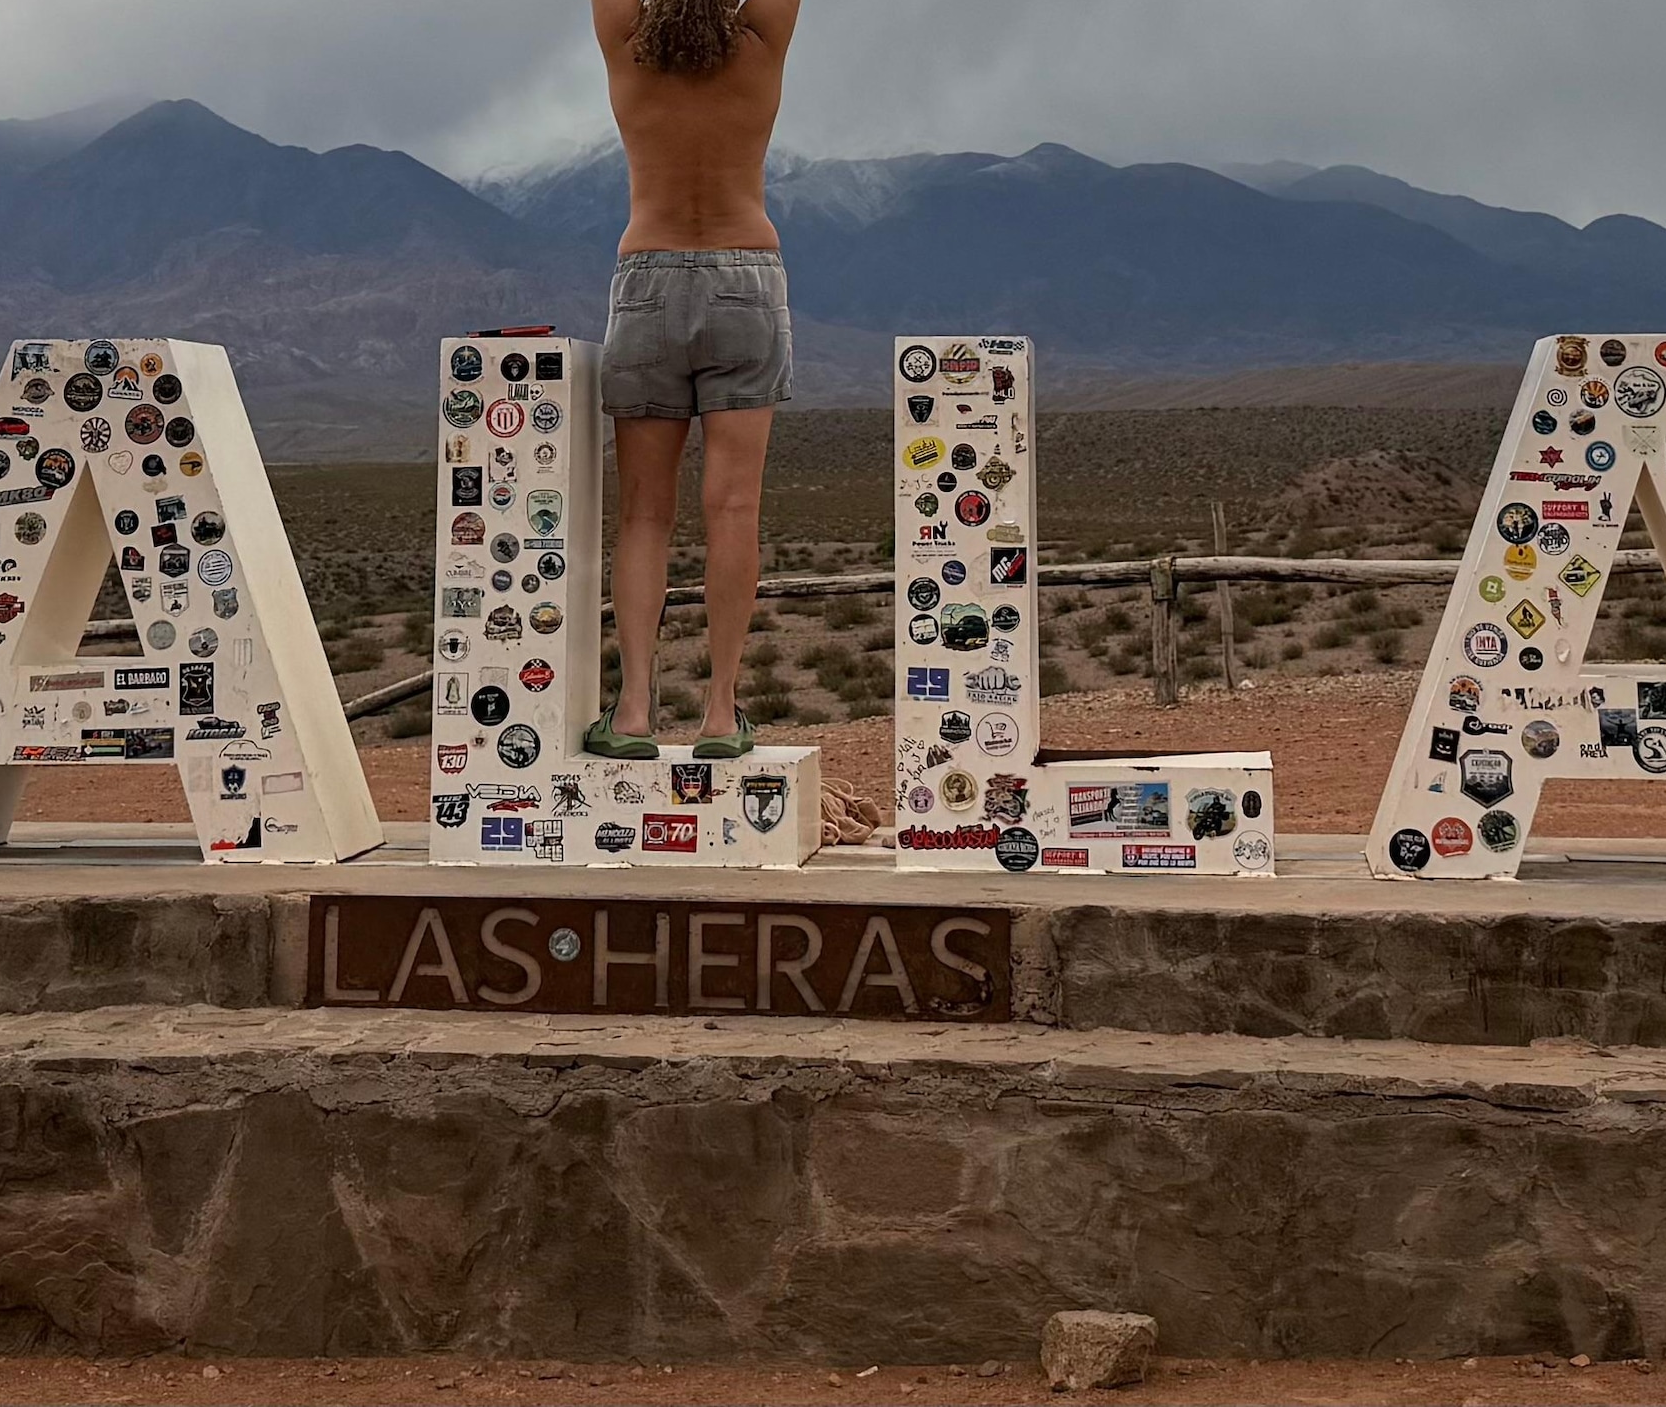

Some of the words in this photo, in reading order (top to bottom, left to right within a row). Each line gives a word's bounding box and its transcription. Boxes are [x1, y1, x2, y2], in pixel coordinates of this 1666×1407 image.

[441, 755, 465, 769] 130
[324, 906, 542, 1003] LAS
[593, 909, 995, 1016] HERAS
